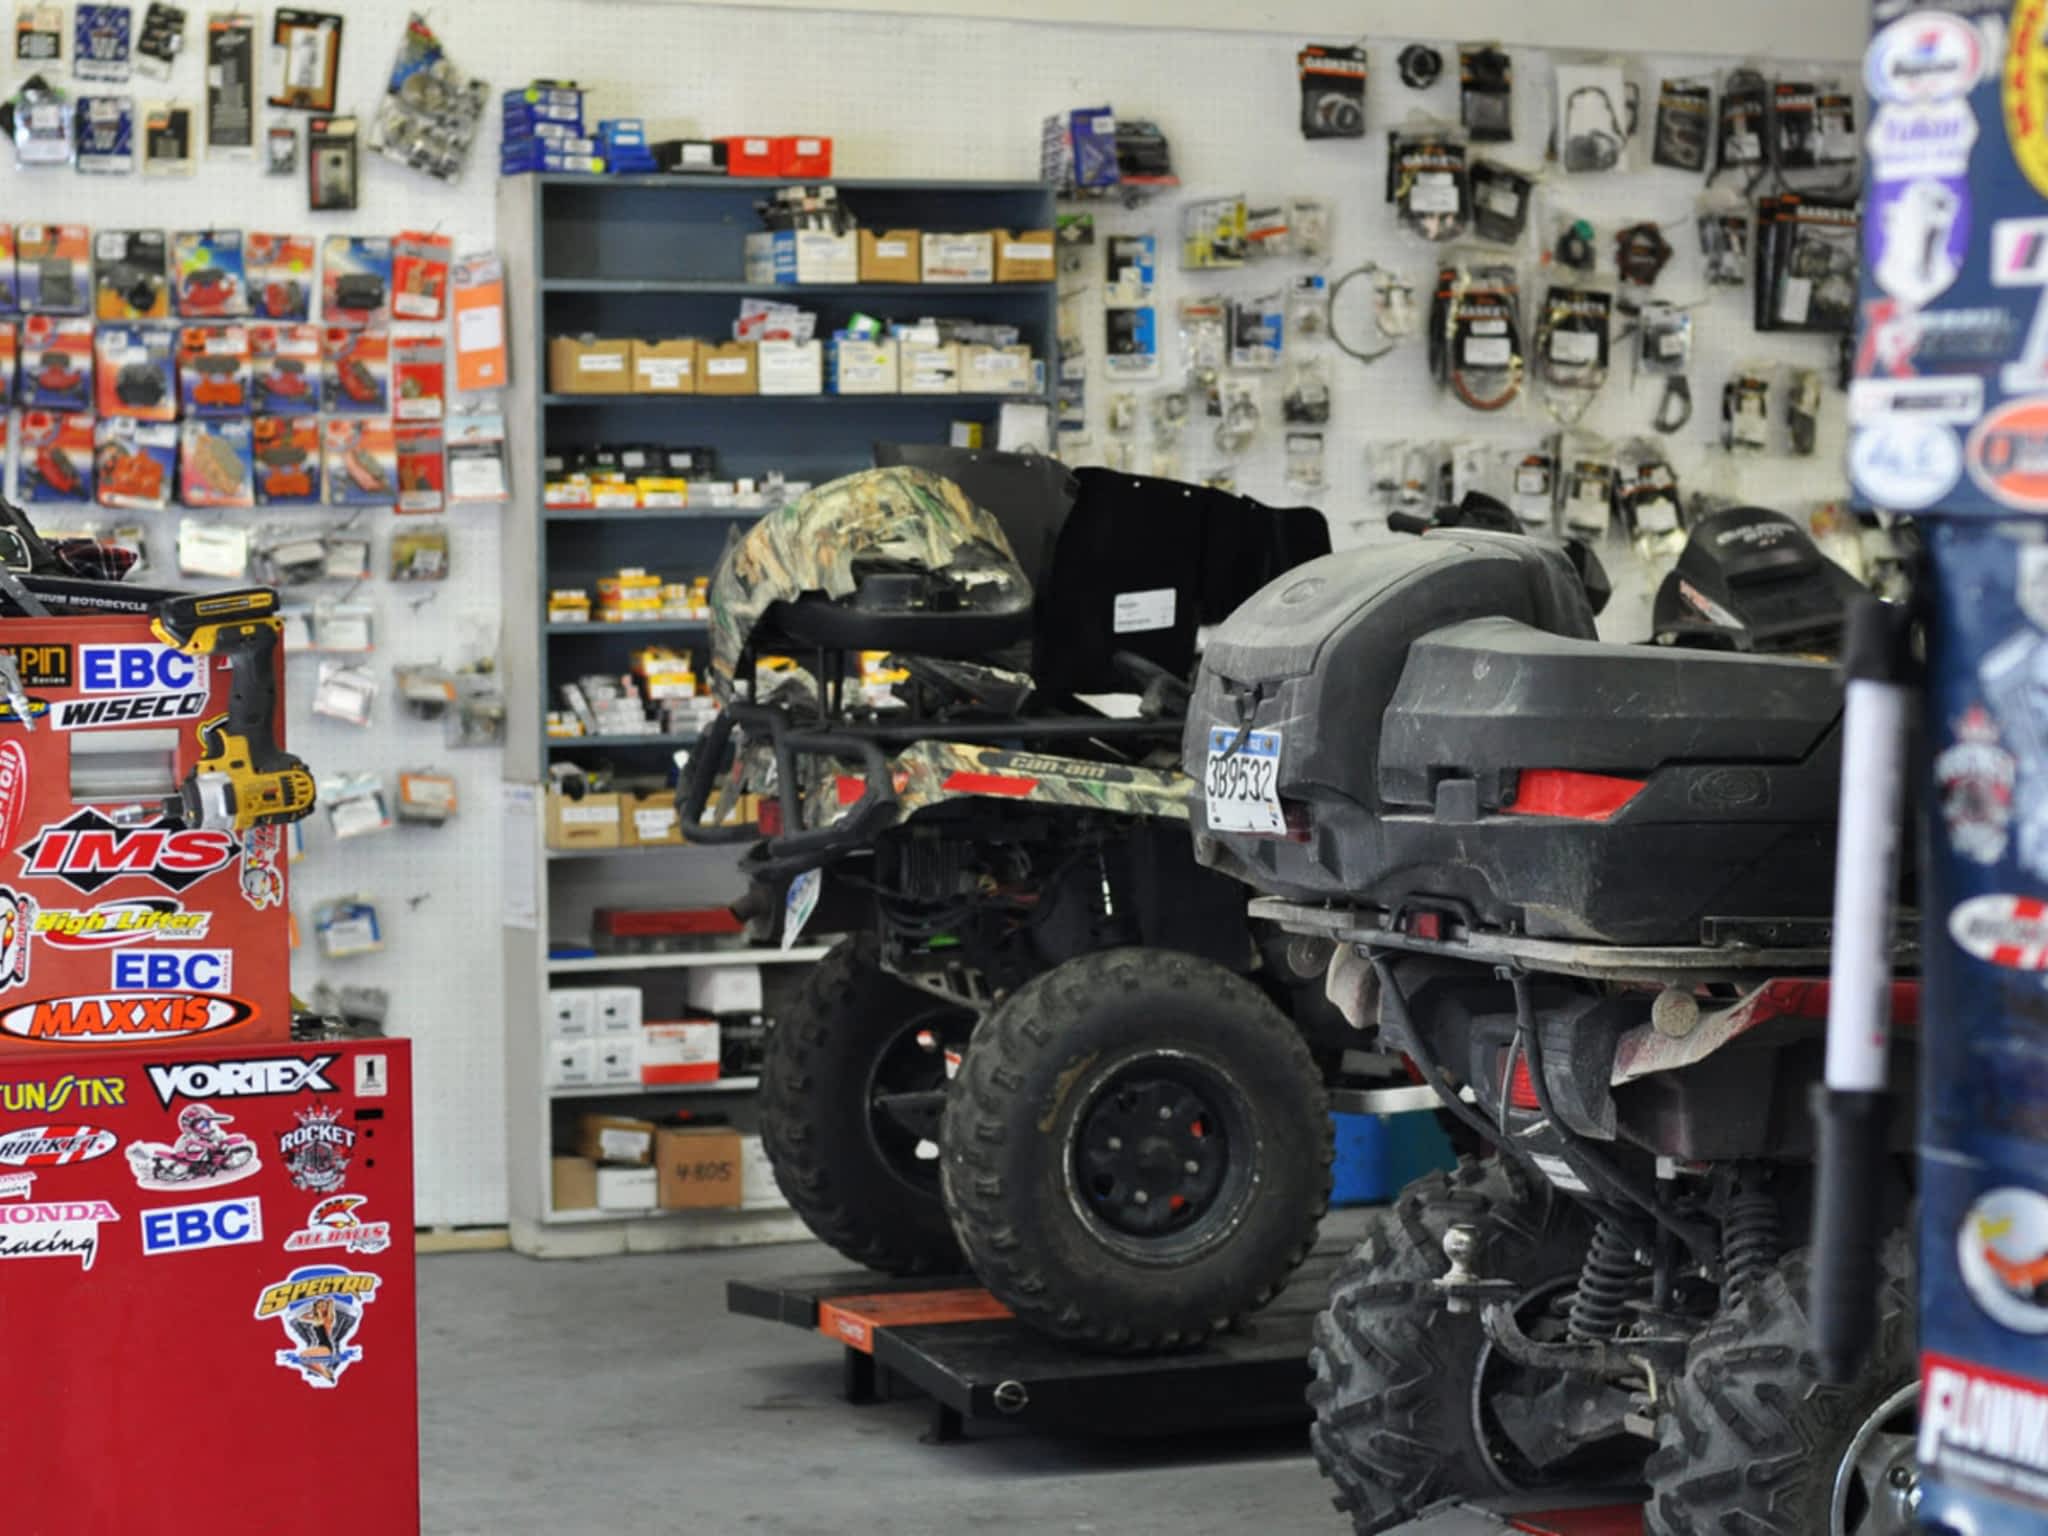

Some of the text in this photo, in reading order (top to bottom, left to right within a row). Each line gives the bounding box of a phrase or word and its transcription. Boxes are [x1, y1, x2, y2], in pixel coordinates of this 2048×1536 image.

[69, 594, 148, 611] MOTORCYCLE
[9, 647, 66, 674] PIN
[84, 649, 195, 689] EBC
[61, 692, 206, 726] WISECO
[33, 831, 231, 871] IMS
[35, 911, 106, 935] High
[117, 909, 204, 931] Lifter
[116, 953, 221, 989] EBC
[29, 997, 210, 1037] MAXXIS
[0, 1075, 125, 1112] UNSTAR
[148, 1055, 336, 1108] VORTEX
[0, 1135, 98, 1157] ROCKET
[281, 1123, 355, 1153] ROCKET
[144, 1205, 250, 1251] EBC
[293, 1227, 386, 1247] ALL BALLS
[259, 1274, 375, 1317] SPECTRO
